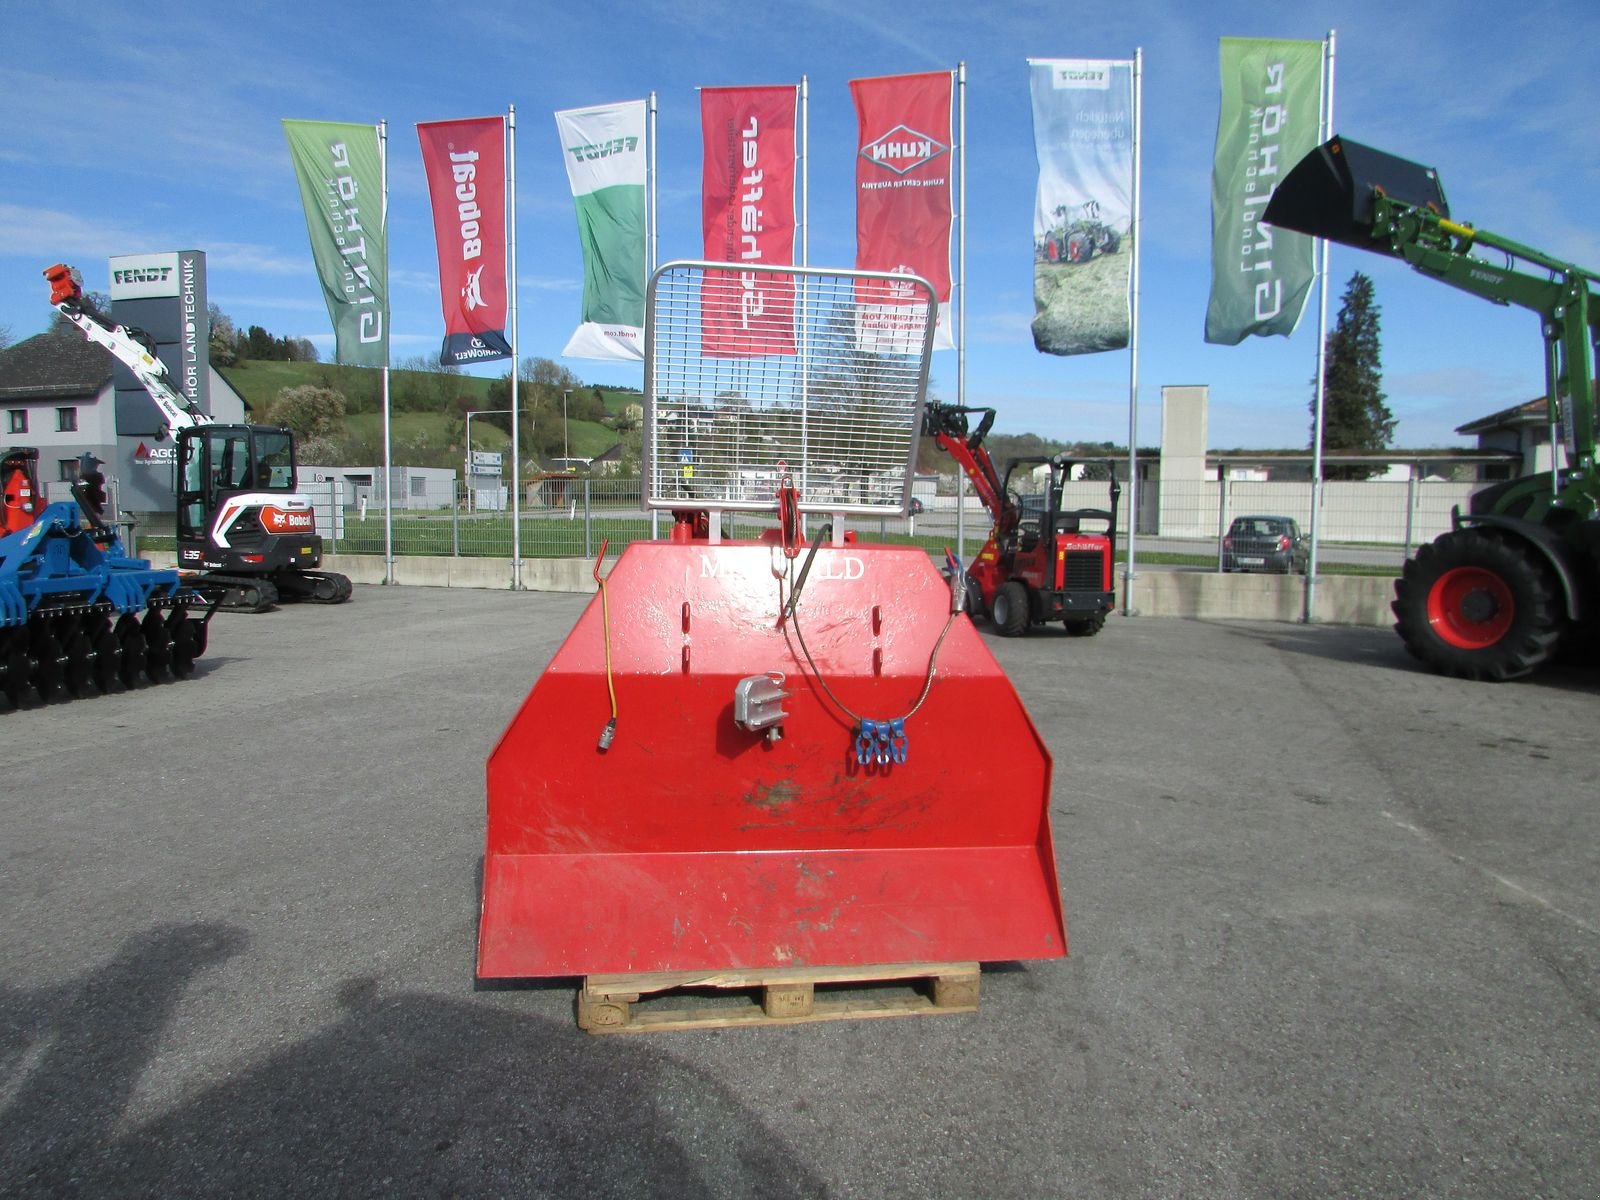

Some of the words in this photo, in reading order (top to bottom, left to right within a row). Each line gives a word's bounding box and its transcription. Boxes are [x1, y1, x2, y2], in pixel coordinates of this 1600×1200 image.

[114, 266, 172, 285] FENDT
[183, 259, 197, 362] LANDTECHNIK
[289, 514, 311, 526] Bobcat
